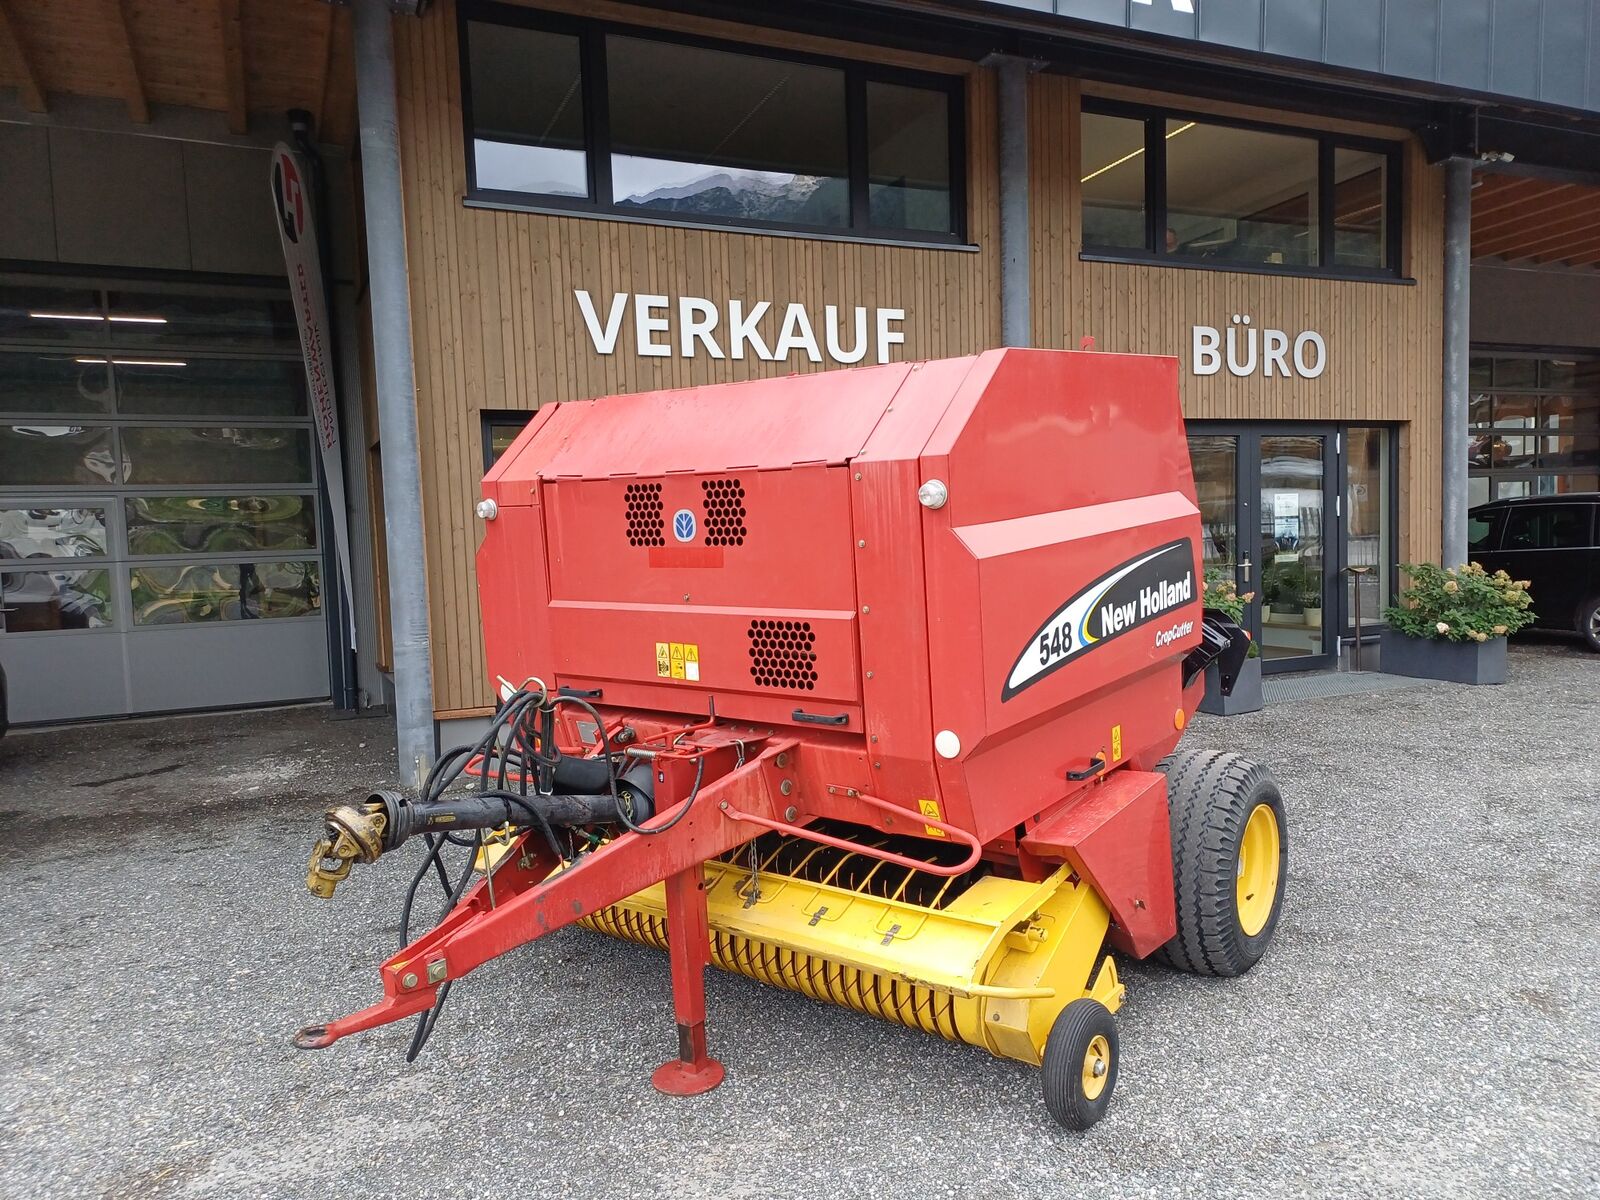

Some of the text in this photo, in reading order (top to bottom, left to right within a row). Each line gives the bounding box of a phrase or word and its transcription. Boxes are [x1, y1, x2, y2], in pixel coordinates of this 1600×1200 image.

[574, 289, 905, 364] VERKAUF
[1192, 313, 1326, 378] BÜRO
[1039, 571, 1191, 666] 548 New Holland
[1155, 620, 1194, 648] CropCutter
